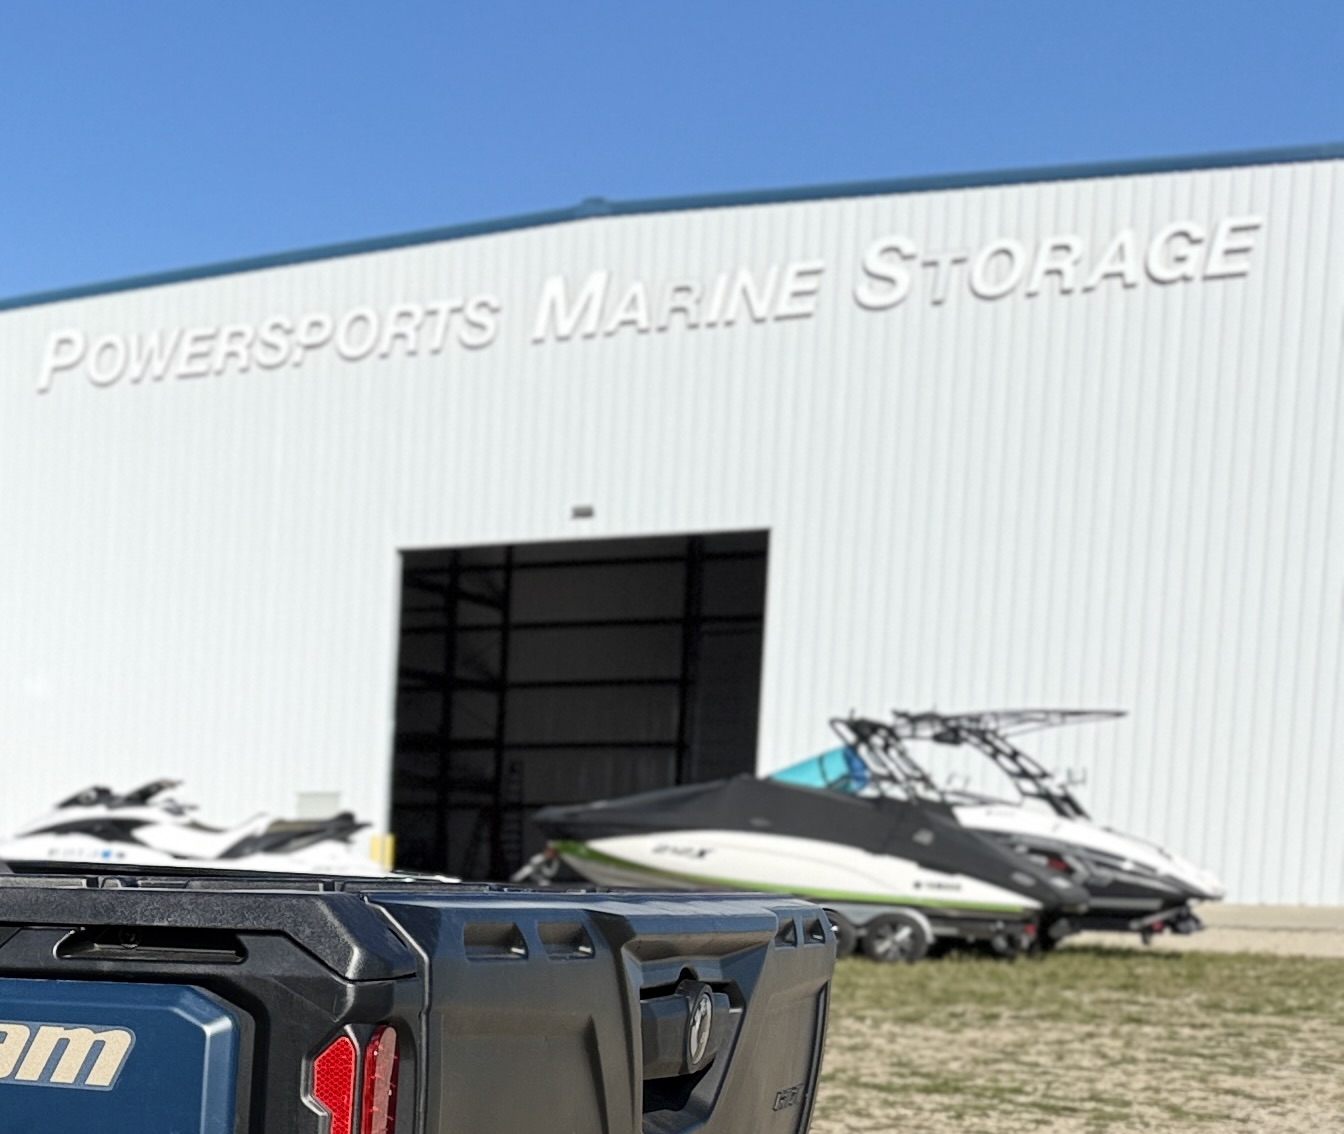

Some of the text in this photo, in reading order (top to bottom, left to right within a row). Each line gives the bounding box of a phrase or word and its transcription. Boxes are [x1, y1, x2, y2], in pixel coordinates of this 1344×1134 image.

[37, 215, 1264, 393] POWERSPORTS MARINE STORAGE
